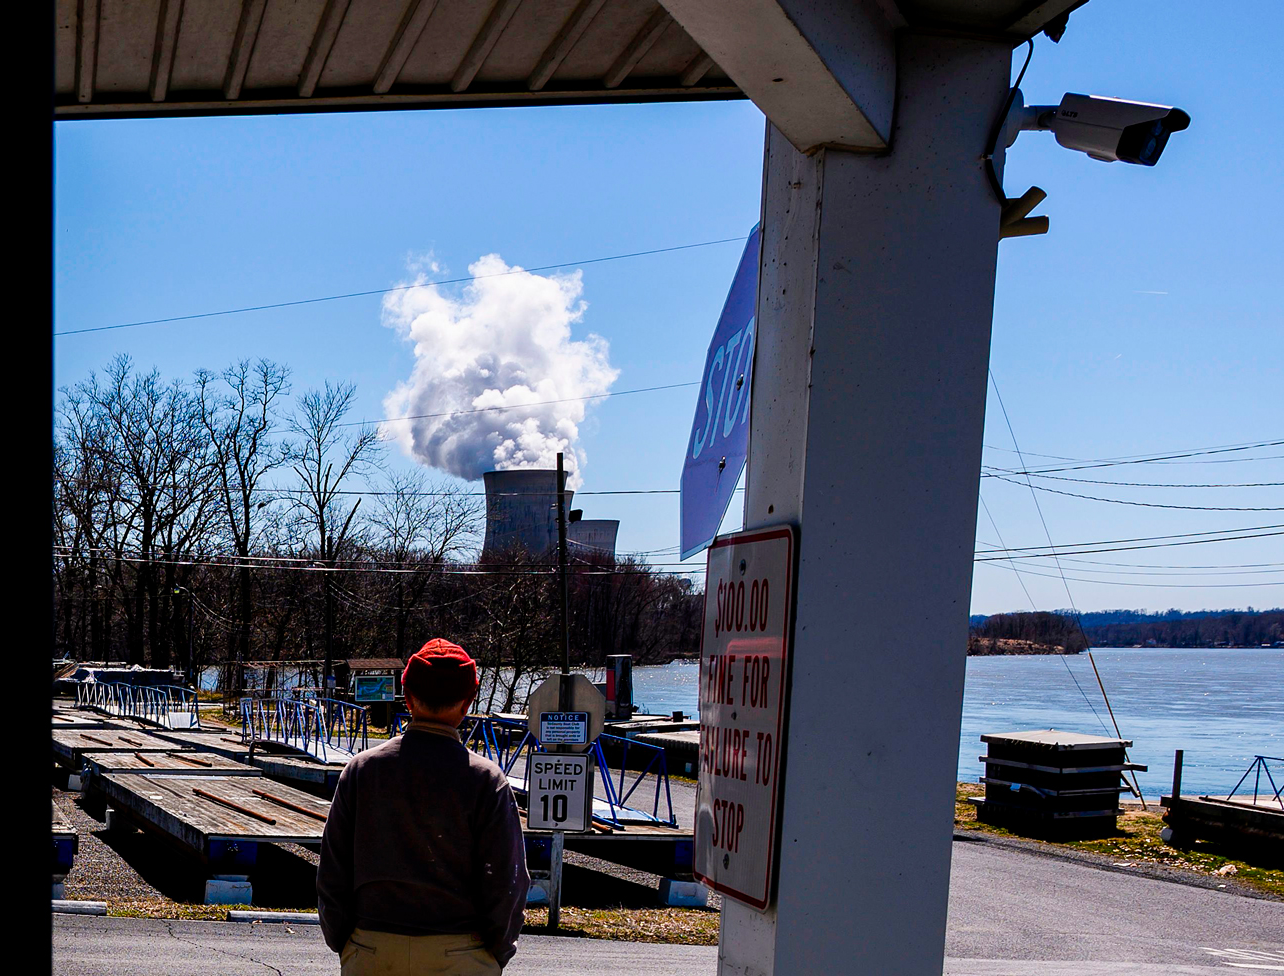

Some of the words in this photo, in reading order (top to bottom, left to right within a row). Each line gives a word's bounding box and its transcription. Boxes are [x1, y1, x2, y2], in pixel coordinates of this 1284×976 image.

[693, 316, 755, 460] STO
[714, 578, 769, 638] $100.00
[707, 655, 736, 705] FINE
[742, 655, 770, 709] FOR
[534, 762, 583, 776] SPEED
[700, 724, 750, 782] FAILURE
[756, 732, 773, 787] TO
[539, 779, 577, 792] LIMIT
[540, 794, 568, 823] 10
[712, 797, 744, 854] STOP
